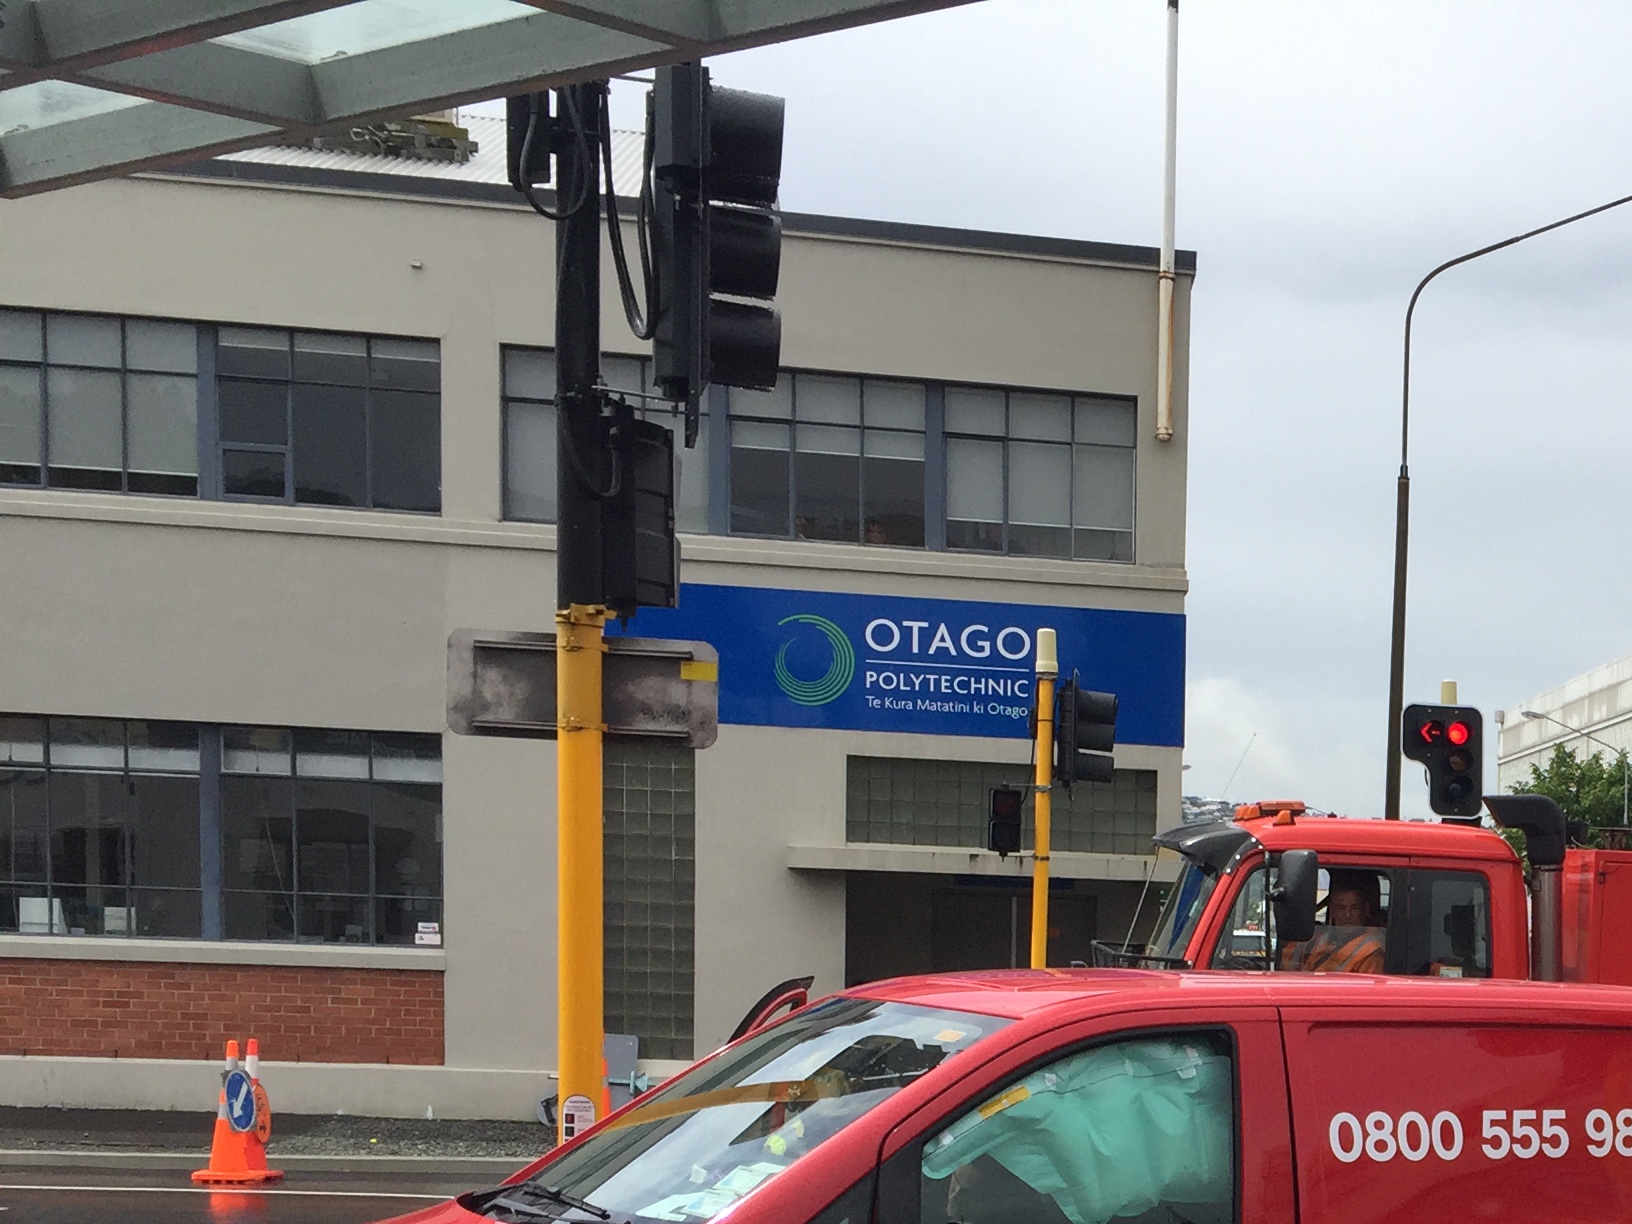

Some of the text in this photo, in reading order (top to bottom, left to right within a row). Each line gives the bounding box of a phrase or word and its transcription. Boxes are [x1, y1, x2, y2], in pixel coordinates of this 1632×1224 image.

[865, 618, 1031, 660] OTAGO
[865, 671, 1029, 697] POLYTECHNIC
[865, 696, 1028, 719] Te Kura Matatini ki Otago
[1329, 1111, 1464, 1163] 0800
[1481, 1109, 1570, 1160] 555
